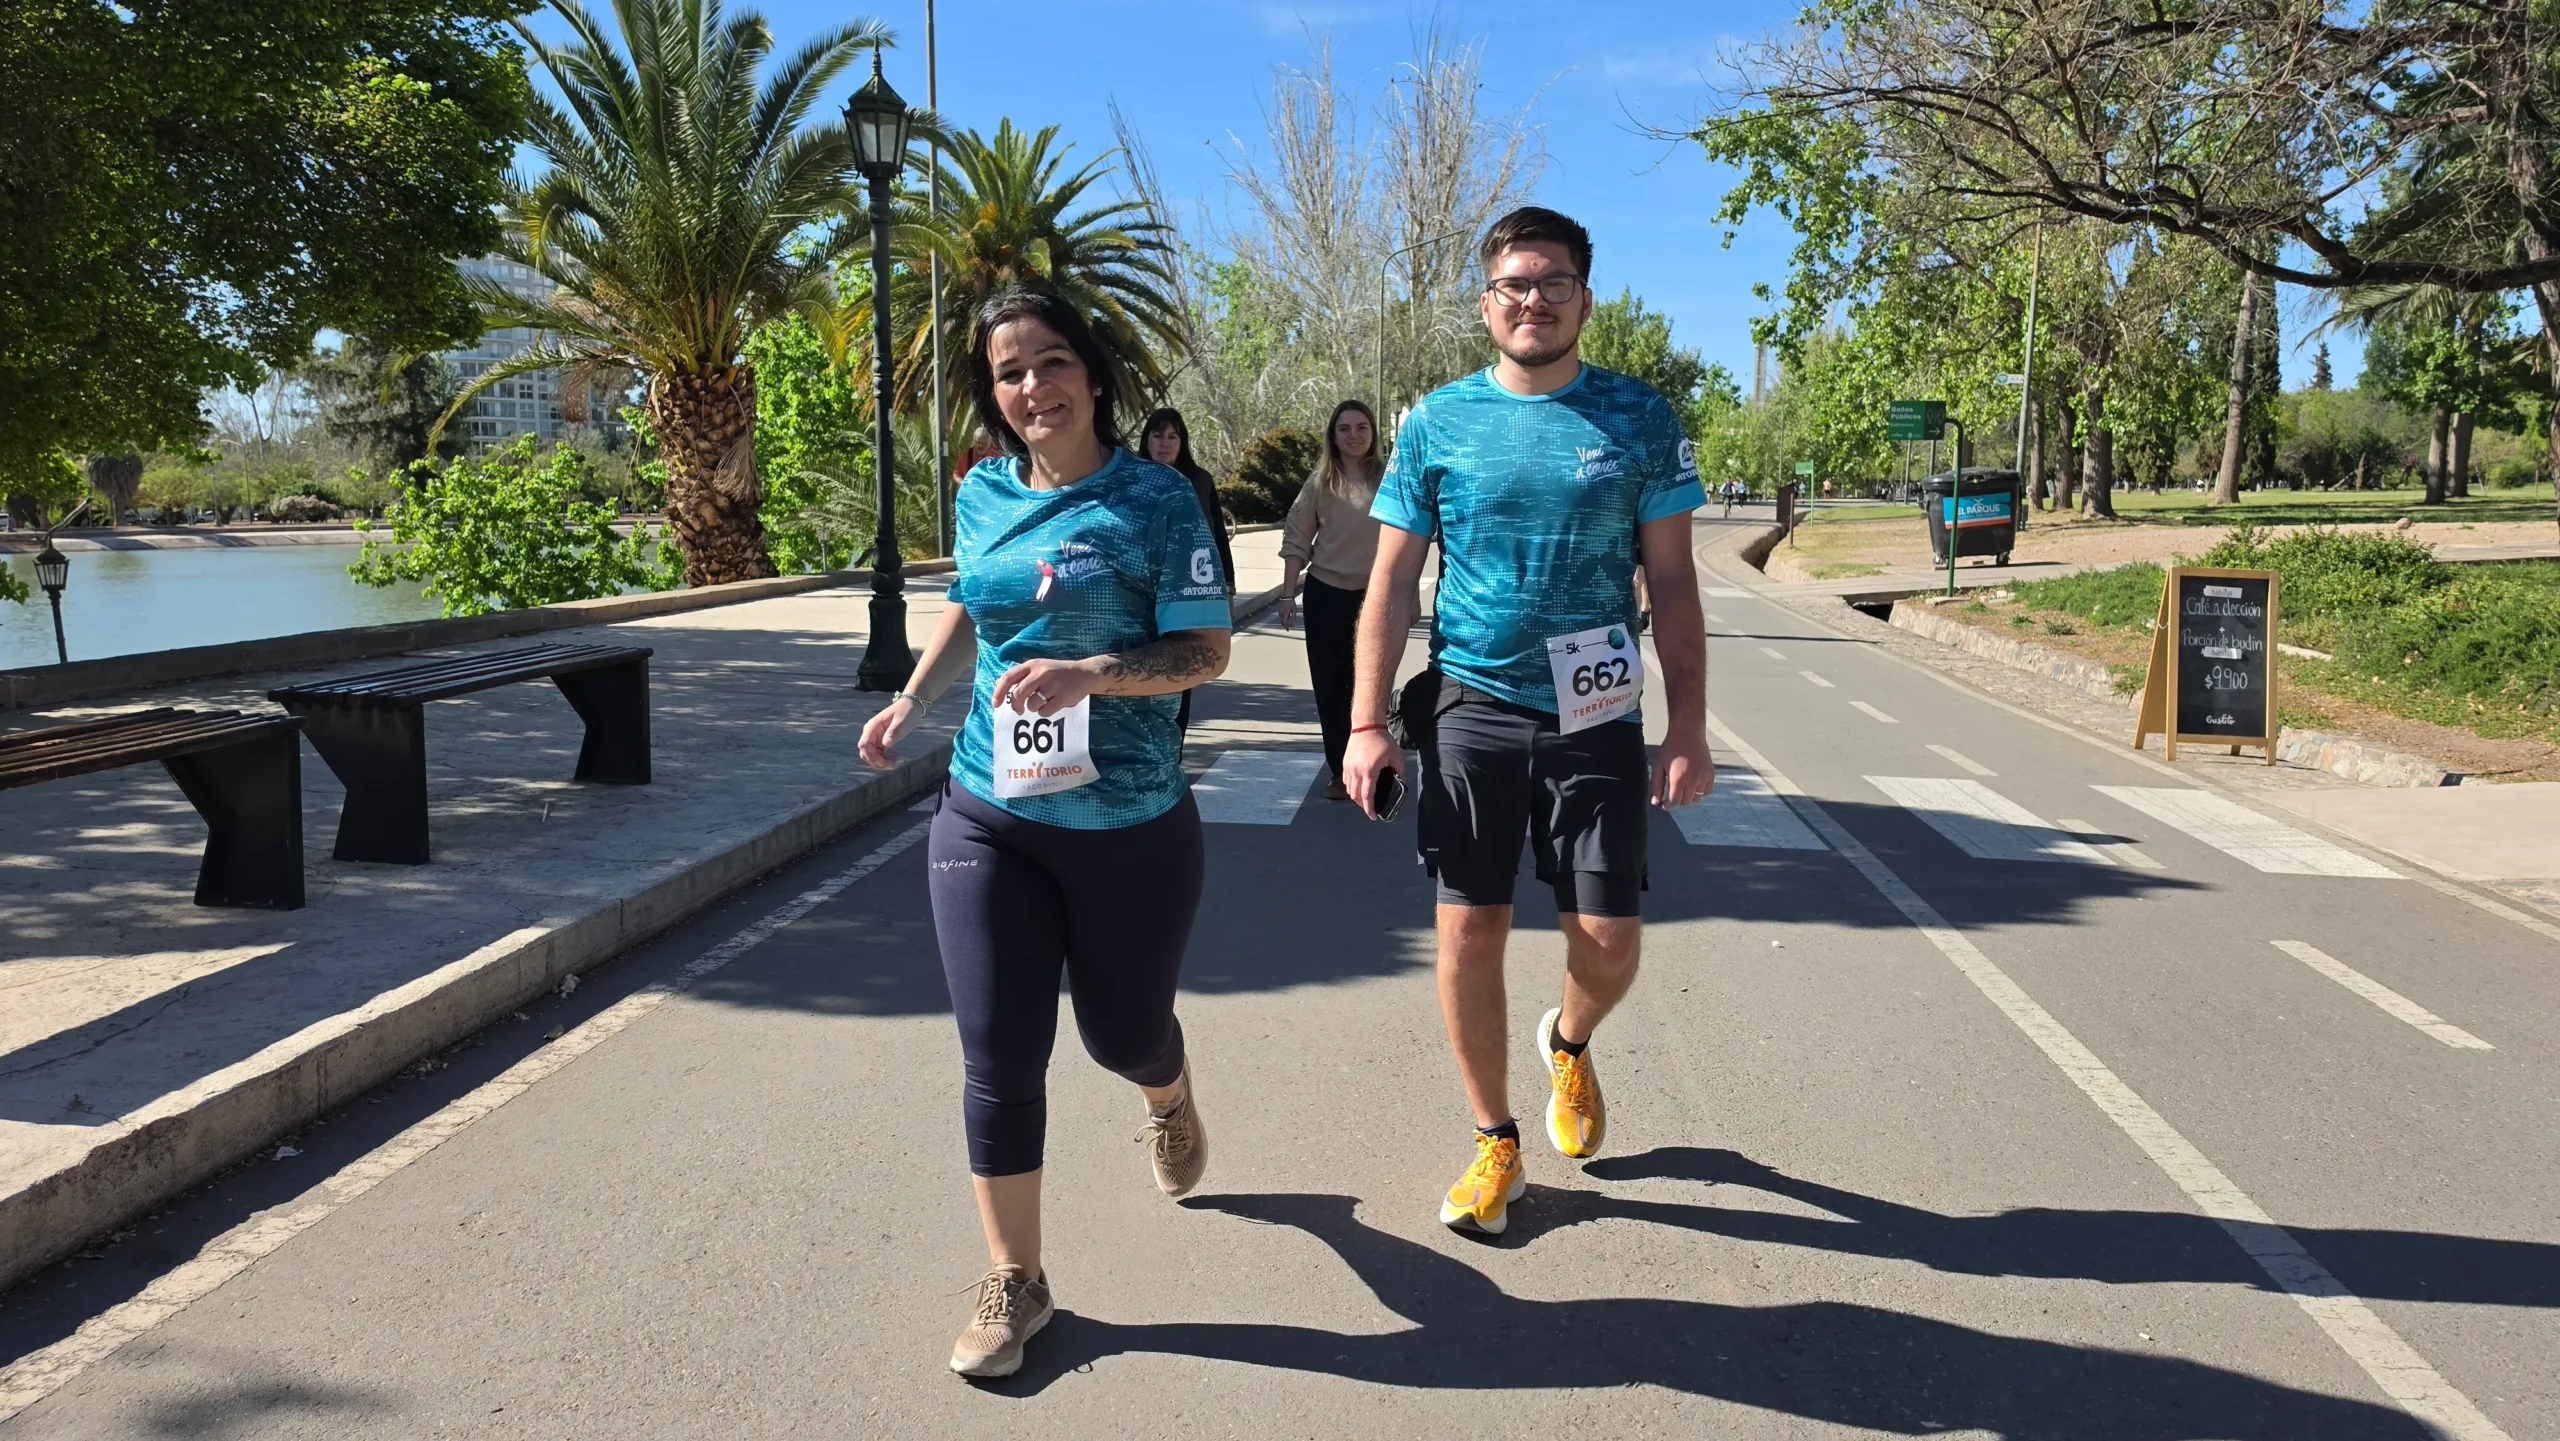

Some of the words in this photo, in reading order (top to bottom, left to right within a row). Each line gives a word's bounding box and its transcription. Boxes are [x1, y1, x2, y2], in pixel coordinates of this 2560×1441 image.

[1575, 466, 1586, 479] a
[1958, 507, 1966, 516] EL
[1966, 503, 2001, 515] PARQUE
[1057, 563, 1069, 578] a
[1183, 586, 1222, 596] GATORADE
[2186, 597, 2210, 615] Café
[2213, 602, 2220, 615] a
[2222, 599, 2261, 617] elección
[2182, 628, 2217, 647] Porción
[2218, 634, 2229, 648] de
[1566, 642, 1581, 655] 5k
[1572, 657, 1631, 697] 662
[1572, 692, 1633, 718] TERRITORIO
[1013, 717, 1065, 754] 661
[1007, 762, 1082, 779] TERRITORIO
